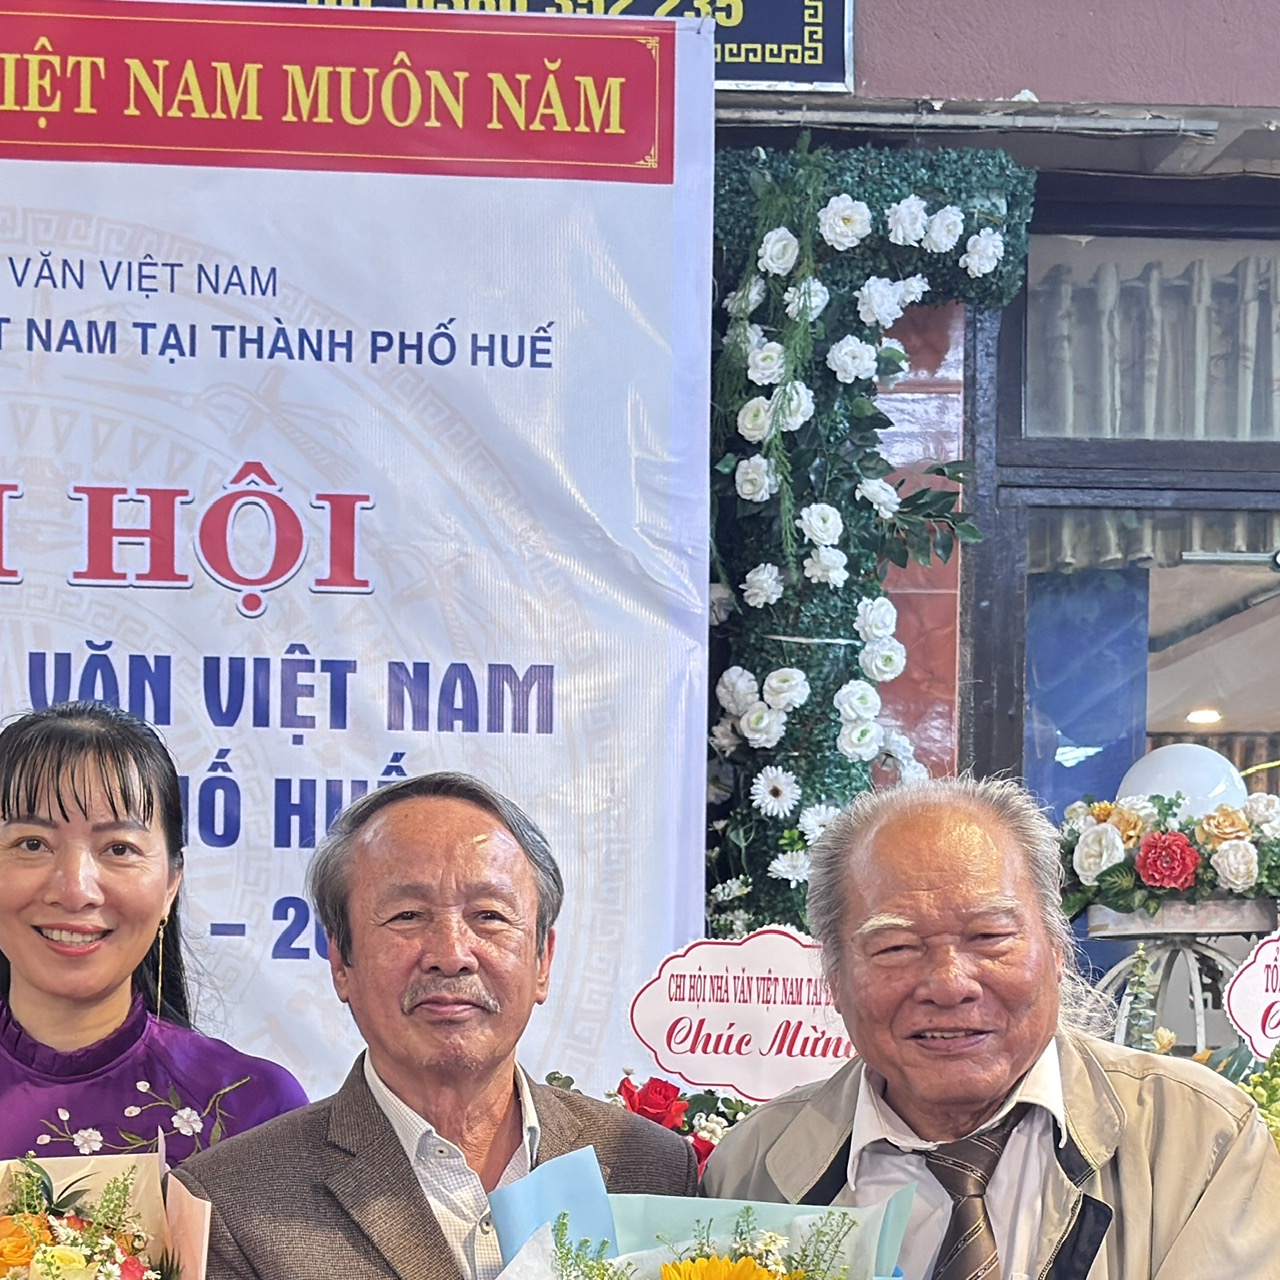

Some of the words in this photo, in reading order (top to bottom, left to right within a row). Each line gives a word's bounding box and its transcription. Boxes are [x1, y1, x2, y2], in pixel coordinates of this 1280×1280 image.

[124, 57, 262, 121] NAM
[283, 52, 468, 129] MUÔN
[488, 62, 625, 134] NĂM
[8, 251, 85, 290] VĂN
[99, 254, 183, 299] VIỆT
[196, 262, 278, 297] NAM
[26, 318, 118, 355] NAM
[132, 321, 197, 365] TẠI
[211, 317, 354, 363] THÀNH
[370, 317, 457, 365] PHỐ
[470, 320, 556, 369] HUẾ
[67, 461, 375, 617] HỘI
[28, 640, 171, 726] VĂN
[203, 643, 357, 745] VIỆT
[388, 661, 555, 734] NAM
[668, 973, 686, 1002] CHI
[688, 966, 707, 1010] HỘI
[708, 966, 730, 1003] NHÀ
[733, 967, 754, 1004] VĂN
[756, 968, 779, 1012] VIỆT
[781, 977, 804, 1006] NAM
[665, 1016, 754, 1056] Chúc
